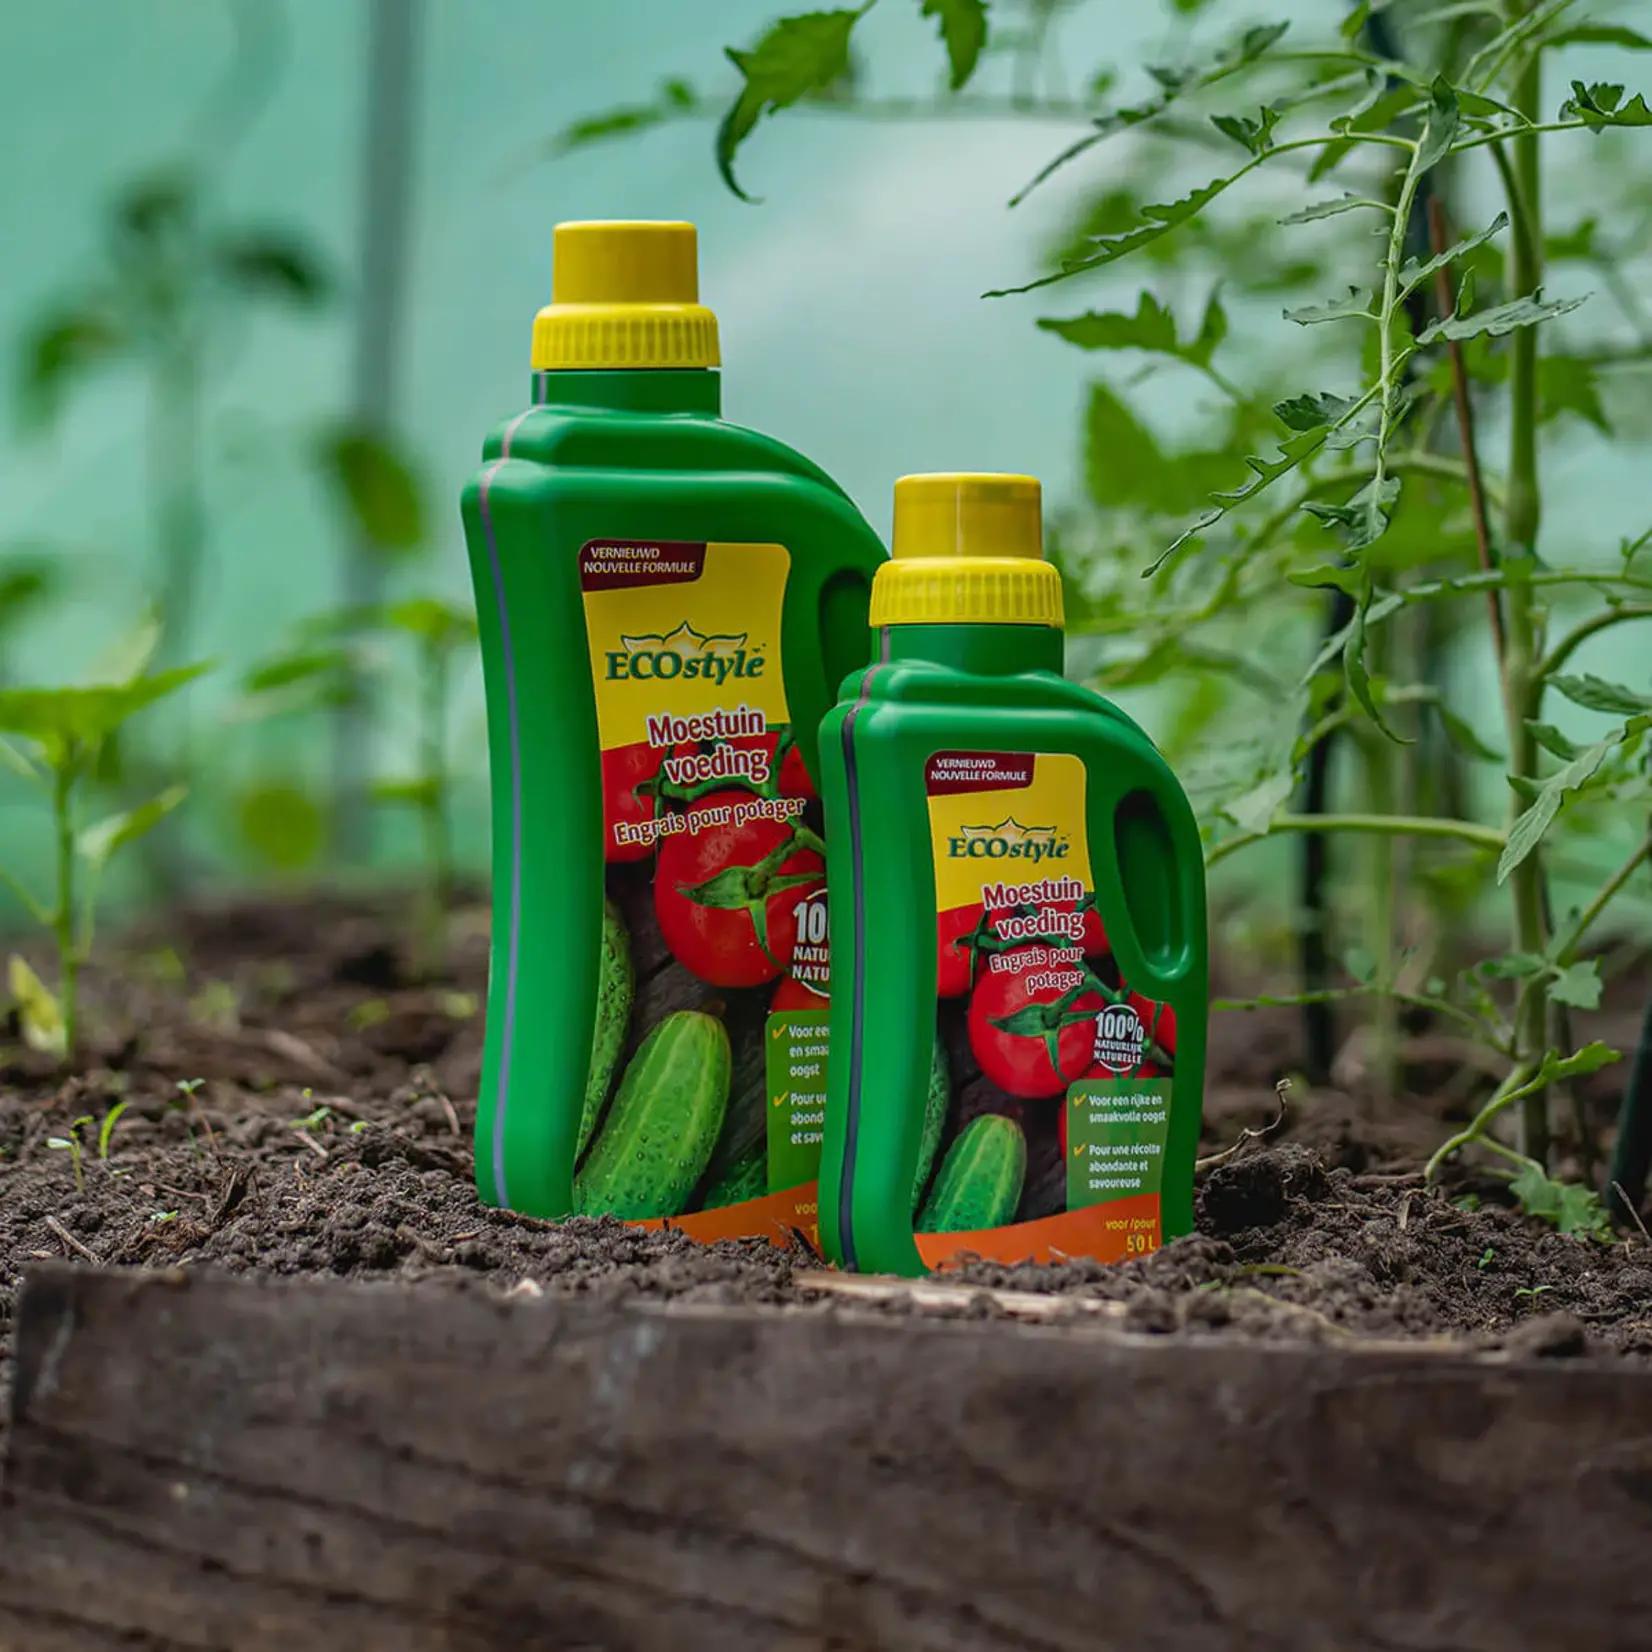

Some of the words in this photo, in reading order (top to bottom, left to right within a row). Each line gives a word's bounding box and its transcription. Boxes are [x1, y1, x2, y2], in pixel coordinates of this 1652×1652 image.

[590, 547, 660, 559] VERNIEUWD
[584, 561, 642, 574] NOUVELLE
[643, 561, 695, 574] FORMULE
[605, 650, 765, 686] ECOstyle
[647, 704, 766, 747] Moestuin
[665, 744, 769, 783] voeding
[936, 758, 996, 769] VERNIEUWD
[931, 769, 980, 781] NOUVELLE
[981, 770, 1027, 782] FORMULE
[614, 811, 686, 846] Engrais
[688, 805, 731, 836] pour
[735, 797, 806, 828] potager
[948, 837, 1070, 863] ECOstyle
[983, 875, 1084, 910] Moestuin
[793, 902, 829, 945] 10
[996, 908, 1085, 940] voeding
[990, 948, 1046, 974] Engrais
[1048, 947, 1084, 968] pour
[1027, 971, 1084, 995] potager
[788, 1025, 813, 1038] Voor
[1095, 1012, 1145, 1042] 100%
[789, 1044, 803, 1057] en
[1093, 1050, 1142, 1065] NATURELLE
[789, 1063, 820, 1079] oogst
[790, 1093, 814, 1106] Pour
[1089, 1095, 1111, 1106] Voor
[1112, 1095, 1129, 1106] een
[1130, 1093, 1150, 1108] rijke
[1151, 1095, 1162, 1105] en
[1089, 1110, 1141, 1123] smaakvolle
[1142, 1110, 1166, 1124] oogst
[791, 1131, 802, 1144] et
[1089, 1144, 1110, 1156] Pour
[1111, 1145, 1129, 1156] une
[1130, 1143, 1160, 1155] récolte
[1089, 1159, 1138, 1172] abondante
[1139, 1160, 1148, 1171] et
[1089, 1178, 1141, 1189] savoureuse
[1126, 1234, 1145, 1253] 50
